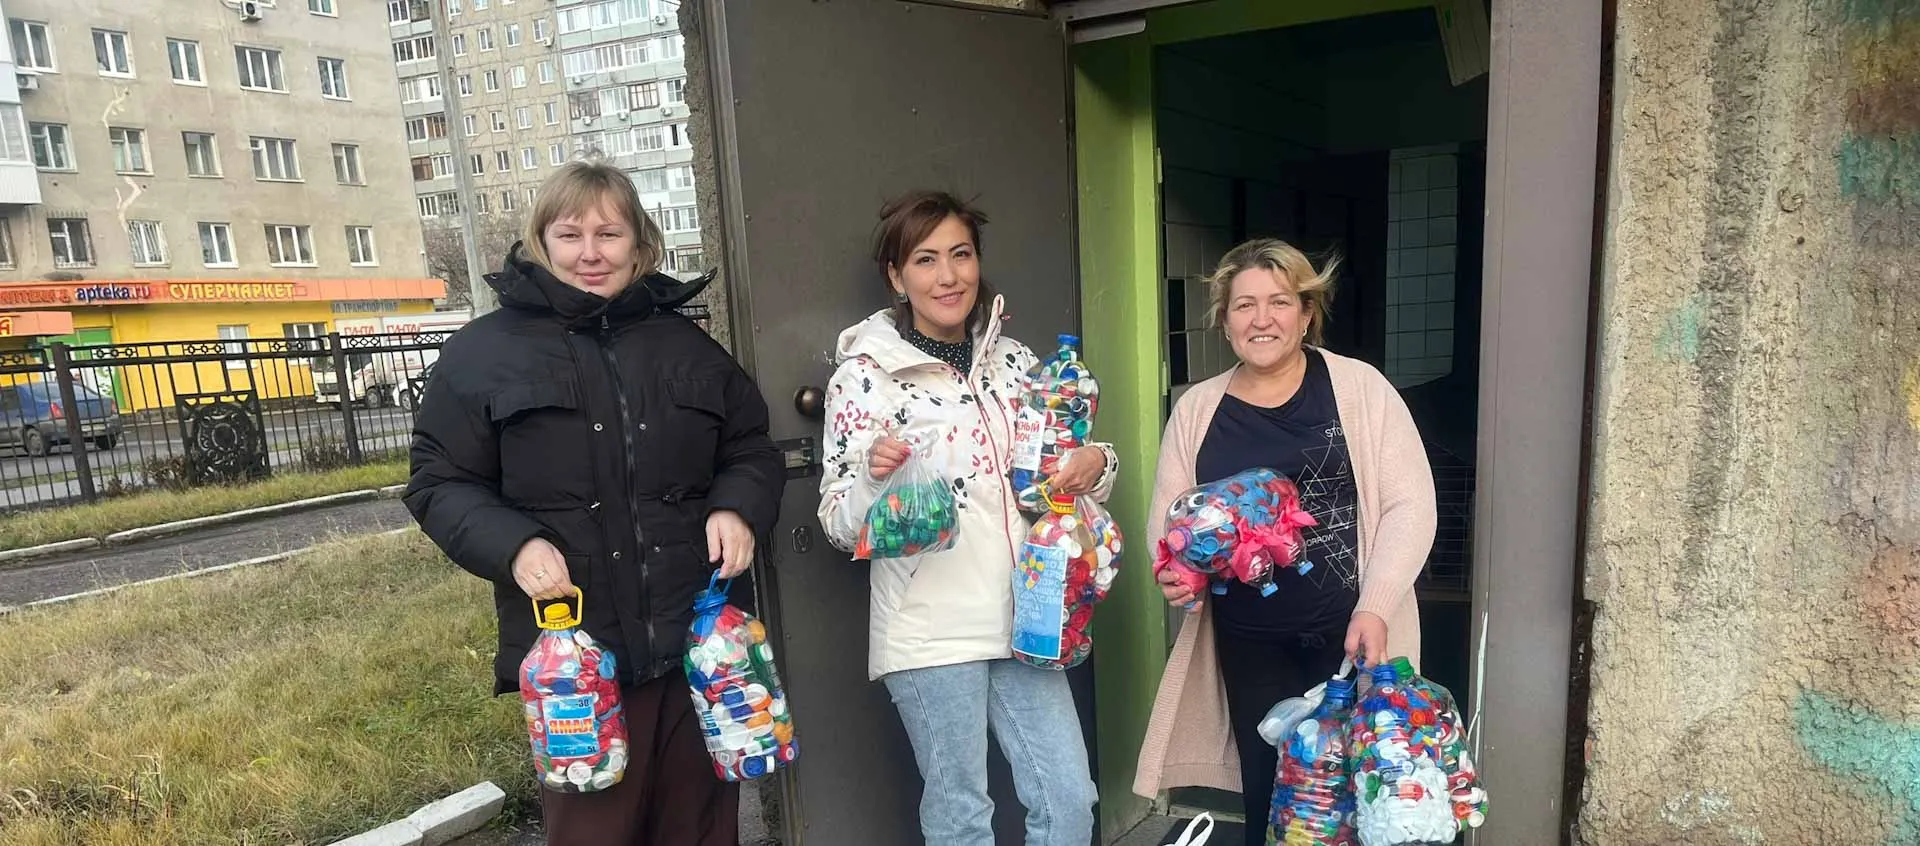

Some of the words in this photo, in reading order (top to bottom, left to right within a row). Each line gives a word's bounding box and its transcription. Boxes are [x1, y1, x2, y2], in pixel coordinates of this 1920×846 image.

[75, 283, 151, 302] apteka.ru
[169, 283, 294, 300] СУПЕРМАРКЕТ
[1016, 420, 1040, 433] СНЫЙ
[1324, 426, 1343, 438] STO
[1015, 431, 1030, 442] ЮЧ
[1306, 533, 1334, 547] ORROW
[548, 718, 594, 735] ЯМАЛ
